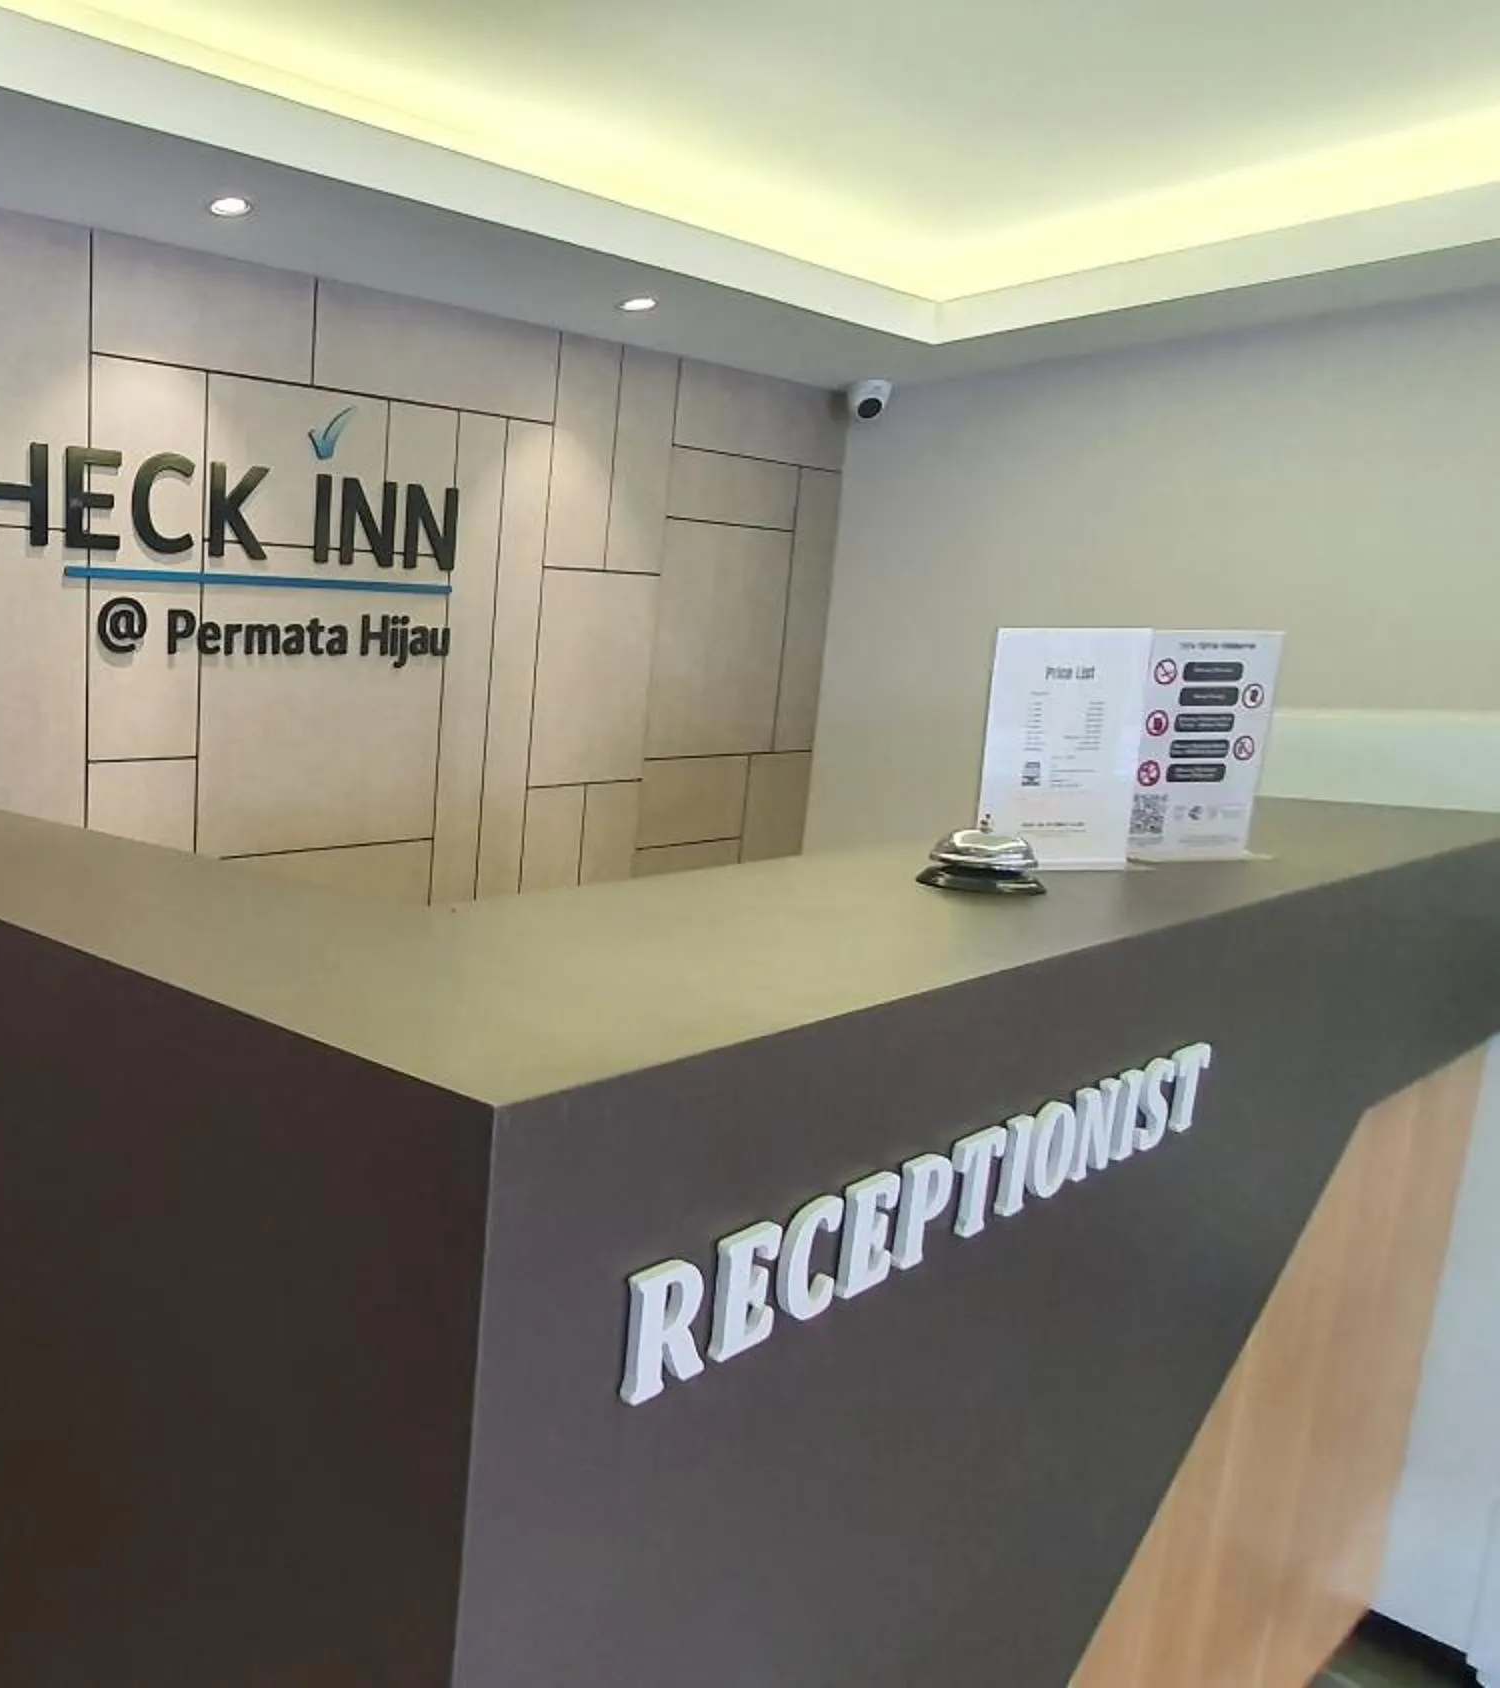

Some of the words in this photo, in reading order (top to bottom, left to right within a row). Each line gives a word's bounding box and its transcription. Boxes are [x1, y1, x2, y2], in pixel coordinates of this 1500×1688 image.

[313, 473, 459, 572] INN
[97, 597, 148, 654] @
[166, 608, 349, 656] Permata
[359, 613, 452, 669] Hijau
[1045, 665, 1072, 681] Price
[1075, 664, 1095, 681] List
[619, 1042, 1212, 1406] RECEPTIONIST
